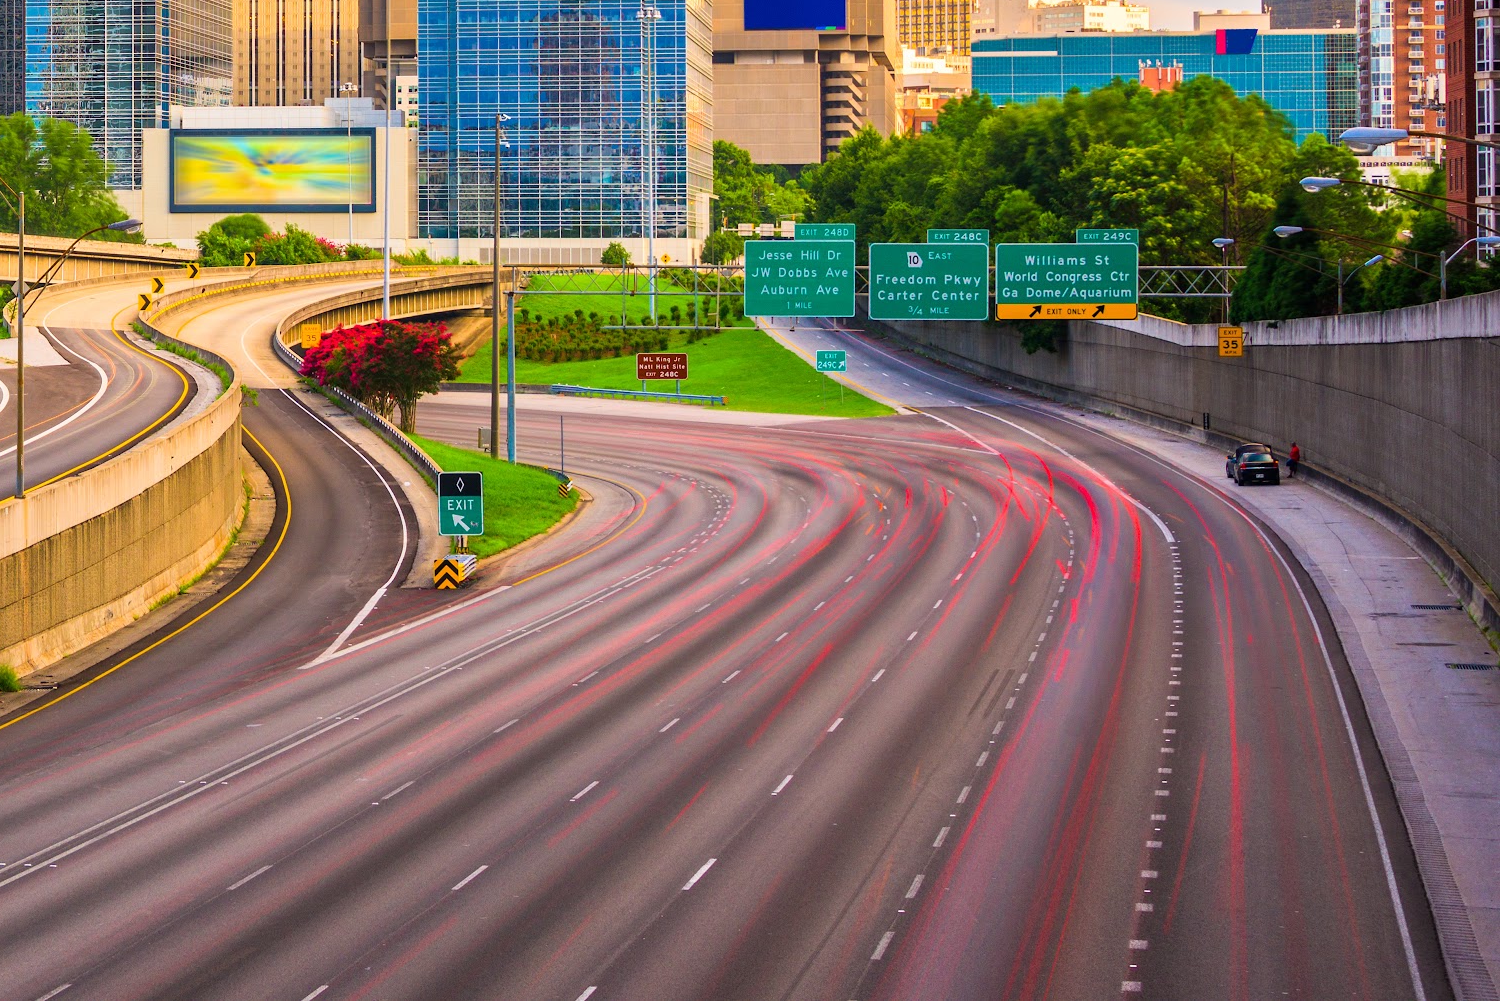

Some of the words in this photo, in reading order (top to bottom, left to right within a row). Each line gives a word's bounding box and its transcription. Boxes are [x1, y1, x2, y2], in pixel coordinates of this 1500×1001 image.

[954, 233, 982, 241] 248C
[1103, 233, 1132, 241] 249C
[759, 250, 793, 260] Jesse
[801, 250, 819, 260] Hill
[828, 250, 841, 260] Dr
[909, 255, 919, 265] 10
[928, 252, 952, 260] EAST
[1025, 255, 1086, 266] Williams
[1095, 255, 1110, 266] St
[752, 267, 770, 278] JW
[779, 267, 817, 278] Dobbs
[826, 267, 848, 278] Ave
[1004, 271, 1038, 282] World
[1046, 271, 1102, 284] Congress
[1110, 271, 1130, 282] Ctr
[876, 275, 936, 285] Freedom
[944, 275, 981, 287] Pkwy
[760, 285, 807, 295] Auburn
[816, 285, 839, 295] Ave
[878, 290, 923, 301] Carter
[932, 290, 979, 301] Center
[1002, 287, 1018, 298] Ga
[1026, 287, 1132, 299] Dome/Aquarium
[908, 306, 923, 315] 3/4
[1223, 340, 1238, 349] 35
[818, 361, 837, 369] 249C
[447, 499, 474, 511] EXIT
